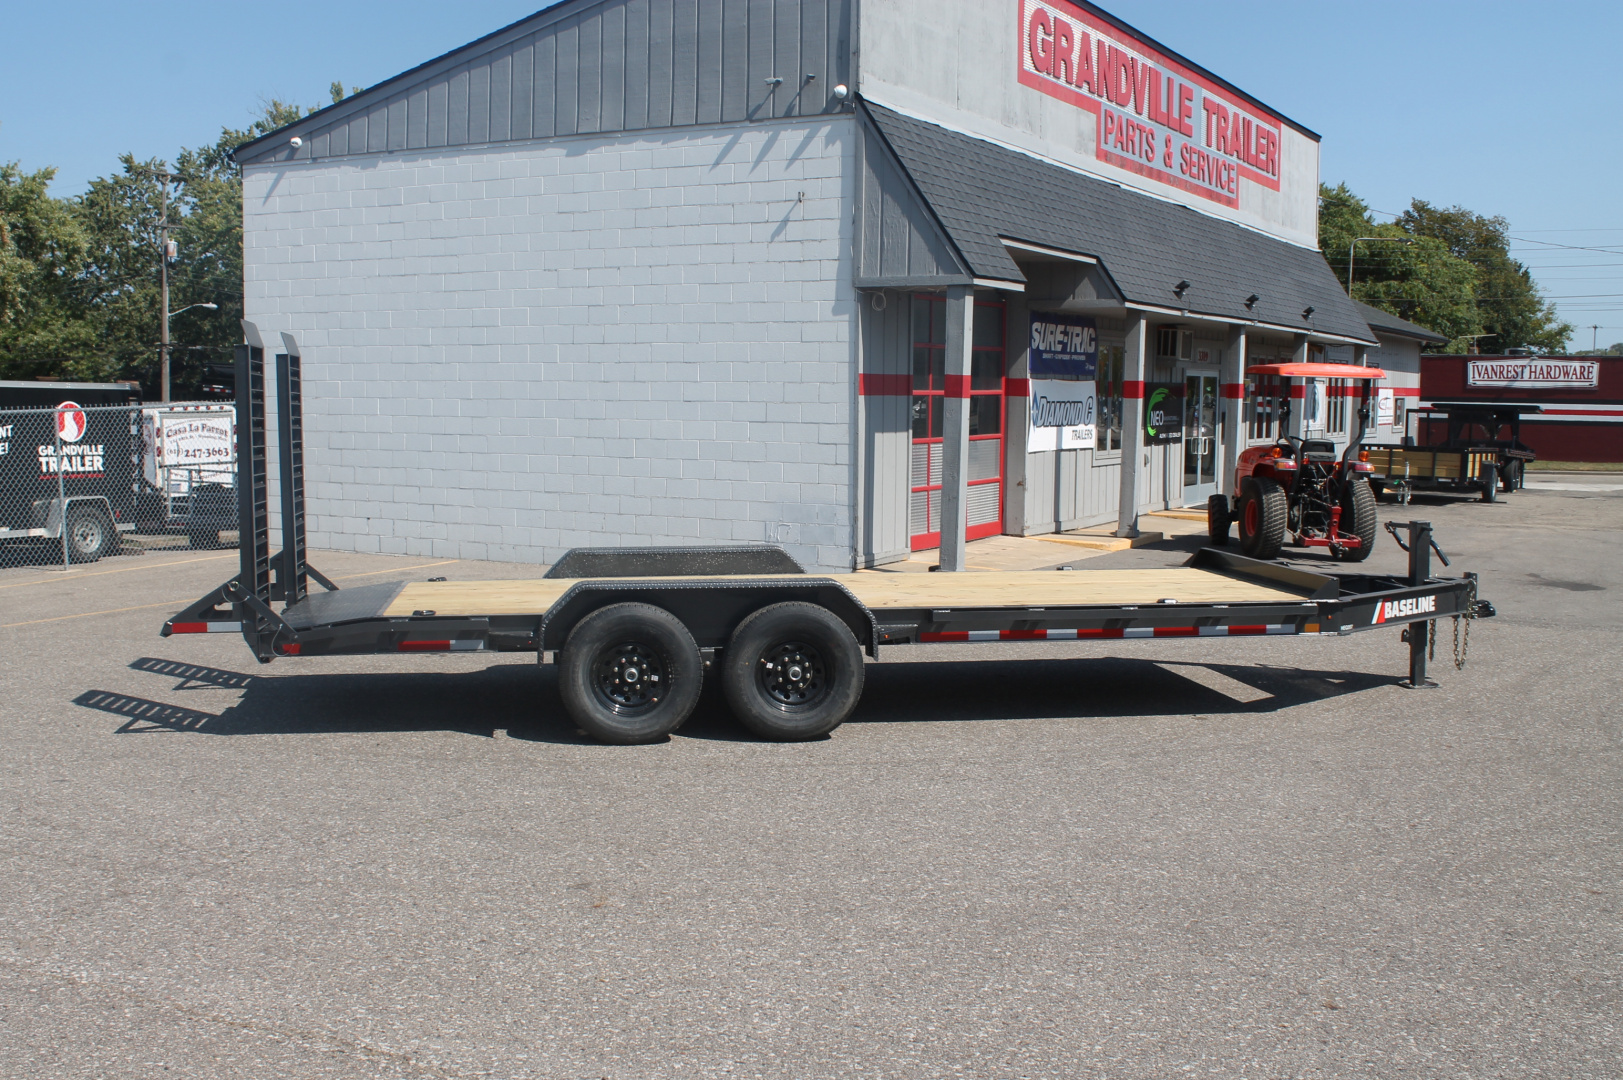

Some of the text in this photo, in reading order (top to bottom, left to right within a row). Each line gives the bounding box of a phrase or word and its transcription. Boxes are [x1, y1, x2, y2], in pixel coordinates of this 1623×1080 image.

[1029, 7, 1278, 177] GRANDVILLE TRAILER
[1104, 108, 1235, 194] PARTS & SERVICE
[1031, 321, 1096, 353] SURE-TRAC
[1471, 364, 1594, 381] IVANREST HARDWARE
[1036, 396, 1094, 427] DIAMOND C
[1150, 410, 1164, 426] NEO
[166, 426, 187, 438] Casa
[188, 423, 200, 433] La
[201, 423, 229, 437] Parrot
[1071, 428, 1093, 442] TRAILERS
[38, 455, 104, 473] TRAILER
[1384, 595, 1436, 619] BASELINE
